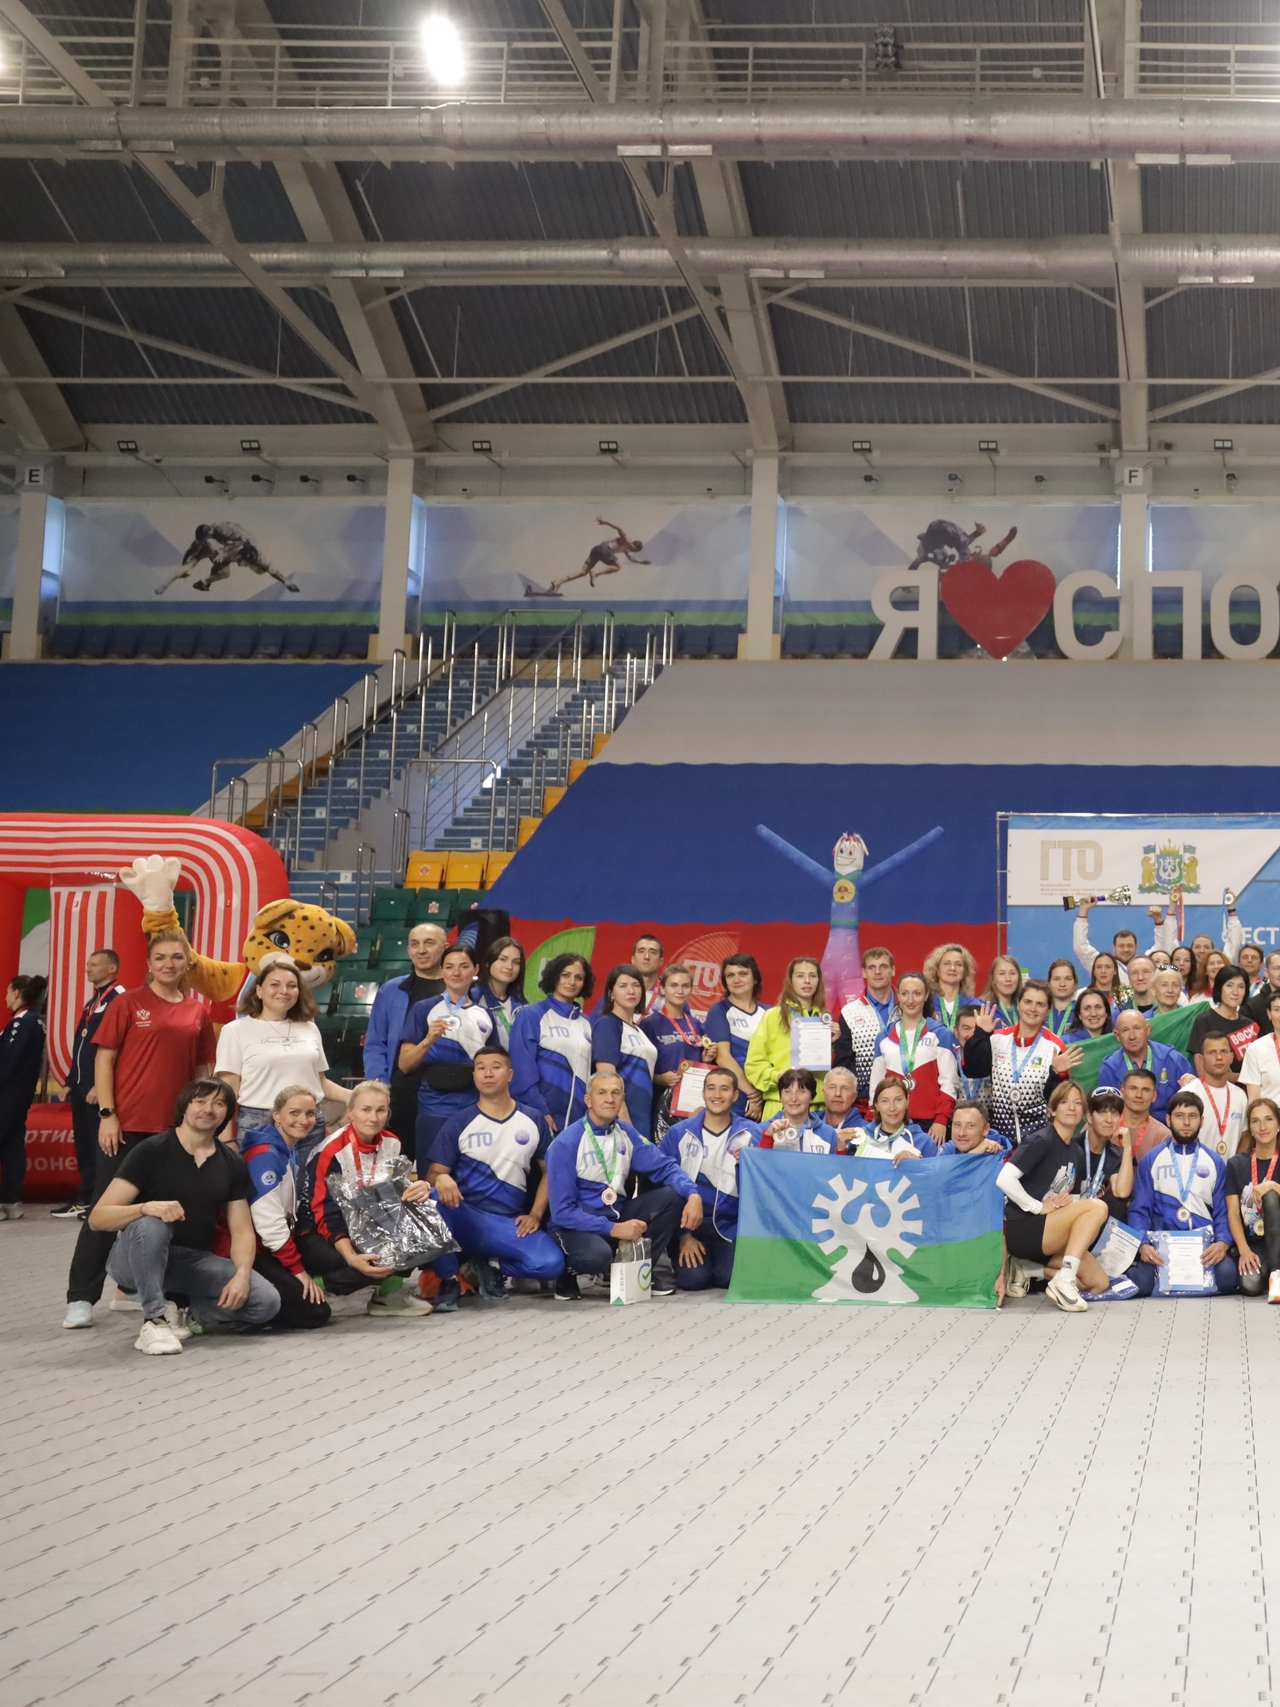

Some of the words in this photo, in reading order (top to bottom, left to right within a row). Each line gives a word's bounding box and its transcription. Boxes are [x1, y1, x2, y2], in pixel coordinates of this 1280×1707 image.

[28, 468, 41, 484] E
[1128, 469, 1139, 484] F
[868, 570, 938, 660] Я
[1041, 840, 1103, 881] ГТО
[550, 1026, 570, 1038] ГТО
[1231, 1025, 1257, 1046] ВФСК
[468, 1131, 494, 1149] ГТО
